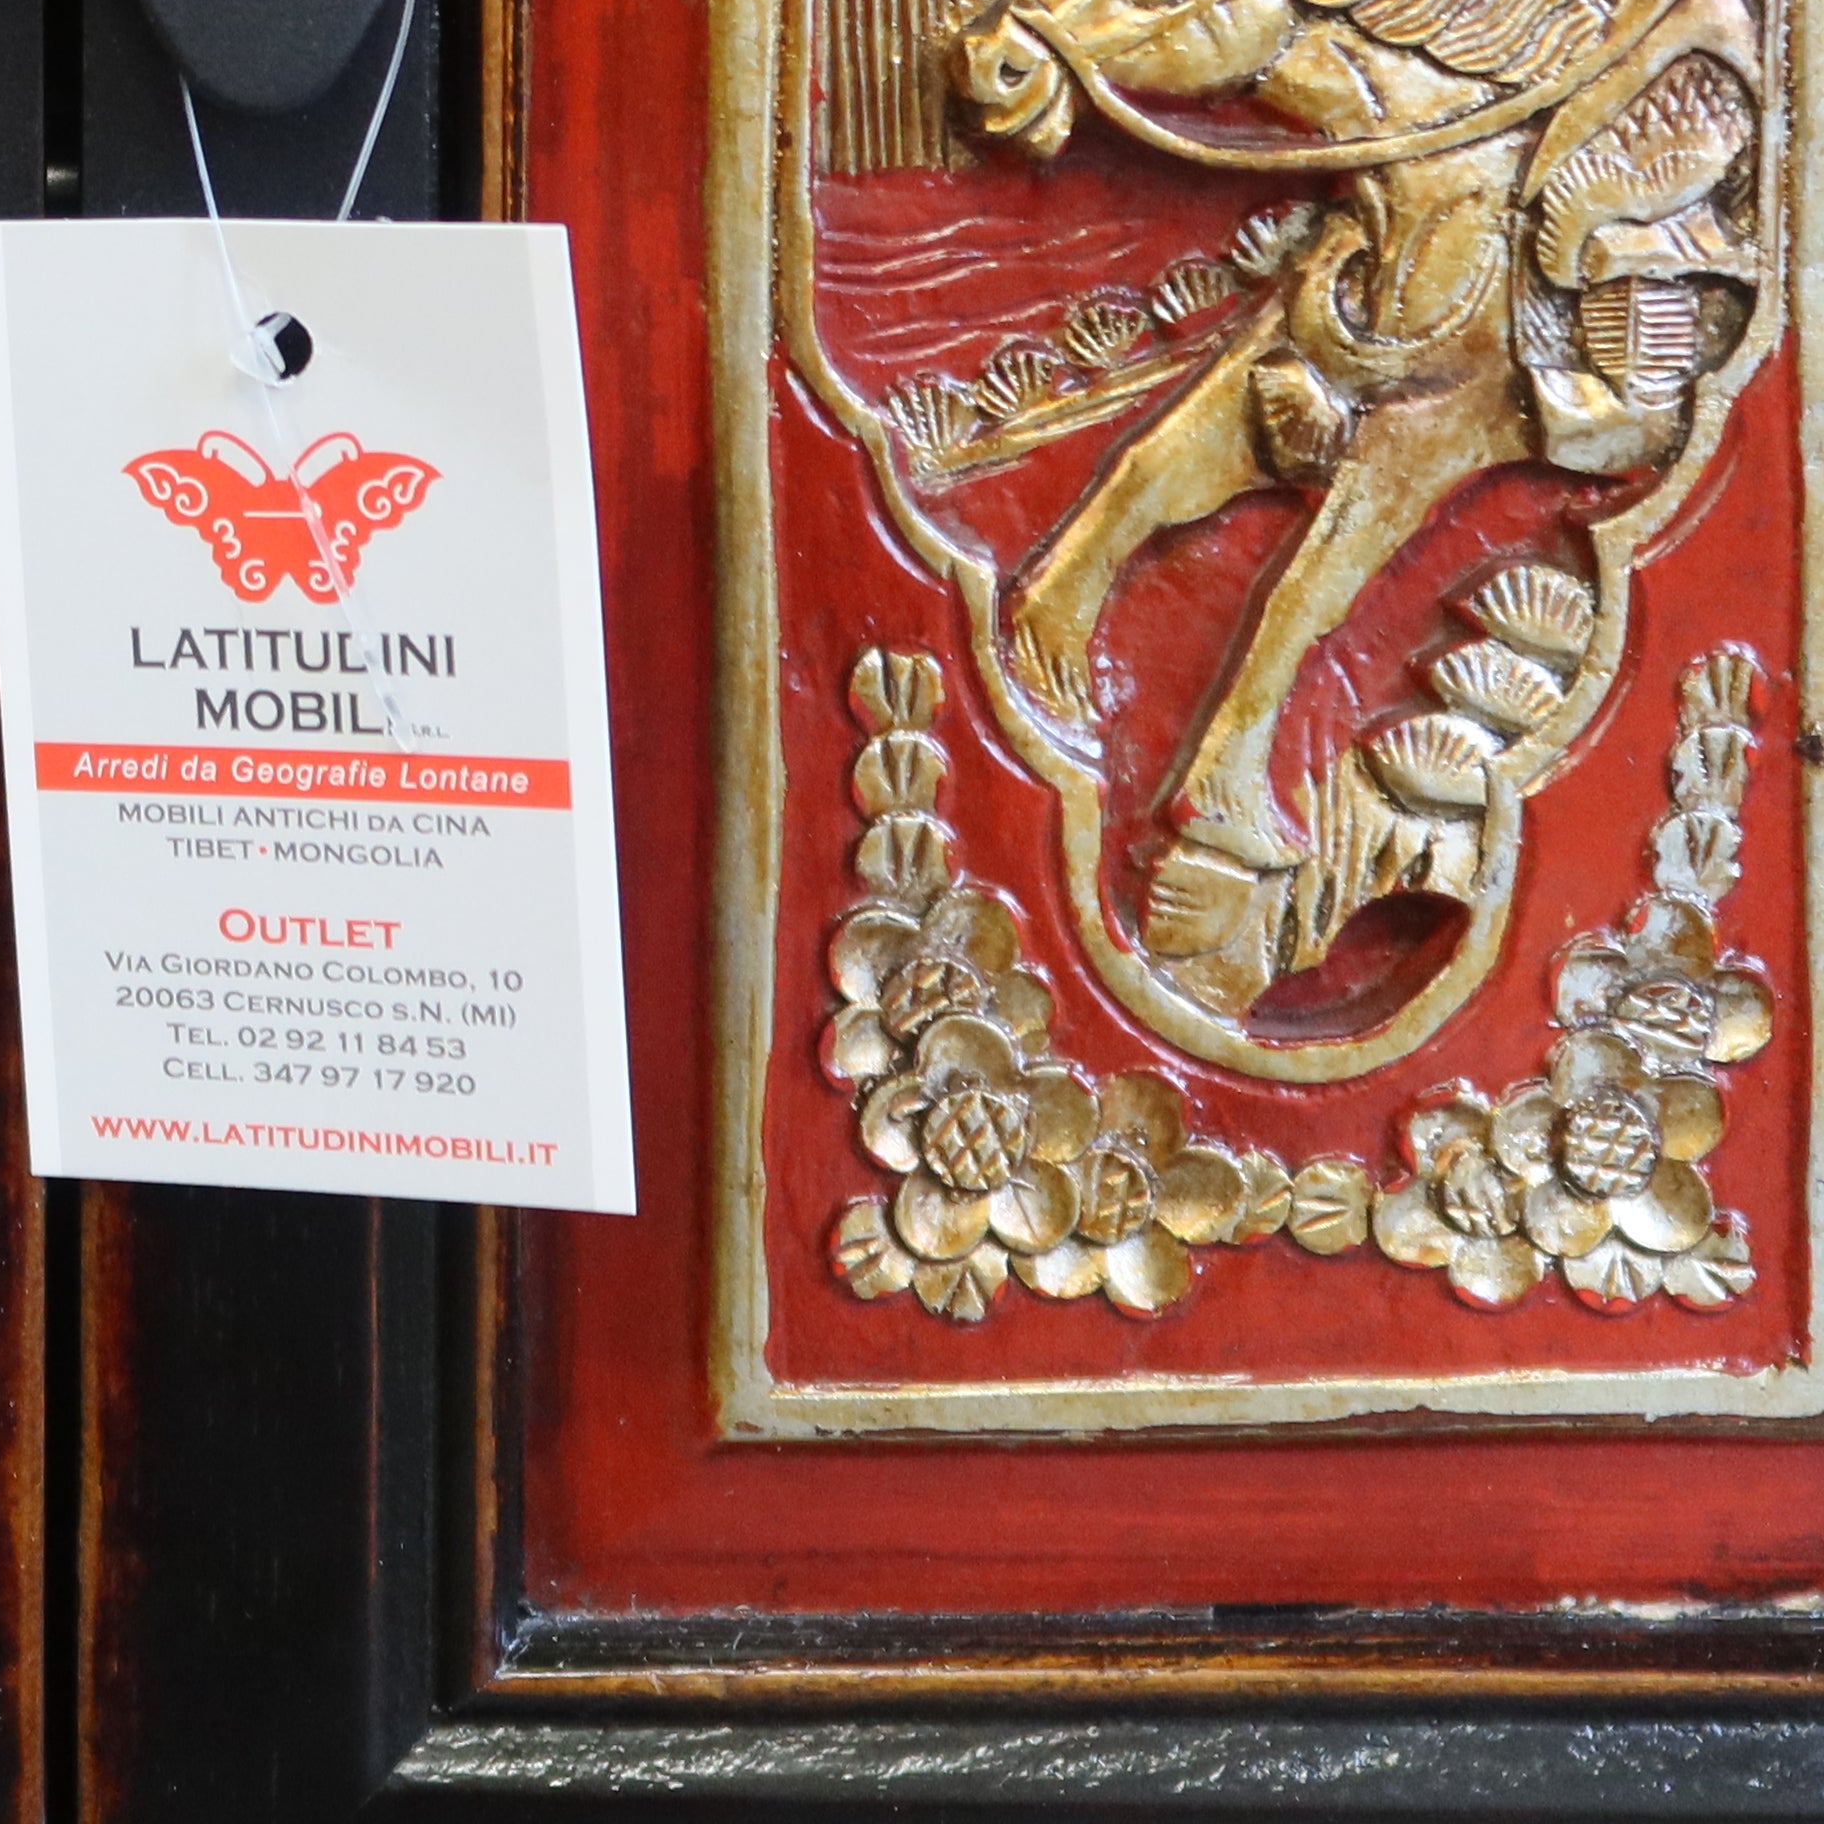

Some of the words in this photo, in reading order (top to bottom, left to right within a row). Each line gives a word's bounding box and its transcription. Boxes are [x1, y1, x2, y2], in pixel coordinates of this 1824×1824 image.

[194, 687, 397, 738] MOBIL
[73, 751, 169, 781] Arredi
[180, 754, 218, 783] da
[230, 755, 387, 791] Geografie
[399, 762, 530, 794] Lontane
[118, 803, 224, 827] MOBILI
[233, 806, 359, 832] ANTICHI
[368, 815, 404, 833] DA
[412, 813, 491, 838] CINA
[166, 837, 255, 861] TIBET
[273, 841, 444, 869] MONGOLIA
[218, 907, 402, 950] OUTLET
[104, 951, 153, 974] VIA
[161, 953, 314, 982] GIORDANO
[322, 961, 477, 993] COLOMBO,
[488, 968, 524, 993] 10
[115, 986, 215, 1011] 20063
[223, 990, 384, 1021] CERNUSCO
[460, 1001, 518, 1029] (MI)
[166, 1022, 229, 1048] TEL.
[237, 1025, 276, 1049] 02
[284, 1028, 327, 1053] 92
[337, 1032, 365, 1055] 11
[376, 1032, 418, 1059] 84
[425, 1037, 467, 1060] 53
[162, 1057, 245, 1084] CELL.
[253, 1060, 313, 1086] 347
[320, 1064, 360, 1088] 97
[373, 1069, 406, 1091] 17
[414, 1069, 477, 1096] 920
[90, 1115, 558, 1166] WWW.LATITUDINIMOBILI.IT
